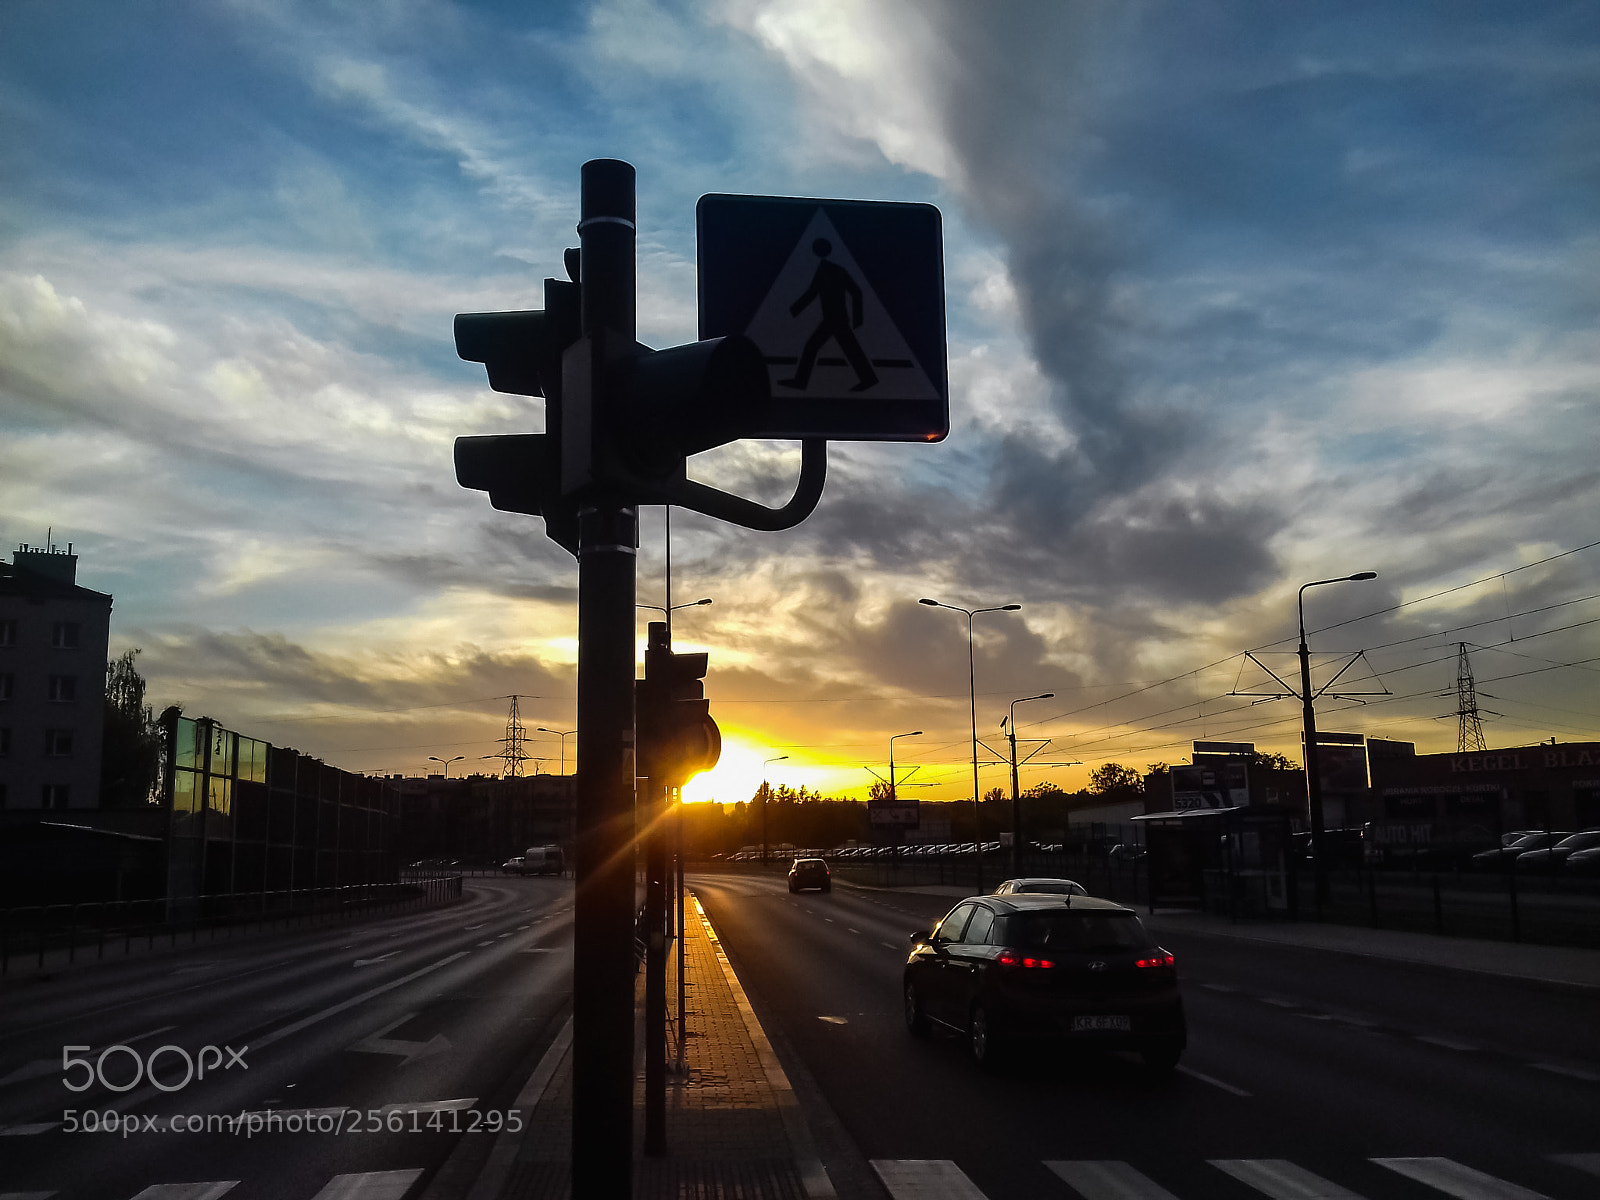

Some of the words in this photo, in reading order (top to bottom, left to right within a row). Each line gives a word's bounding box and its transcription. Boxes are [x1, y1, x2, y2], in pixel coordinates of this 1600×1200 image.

[1450, 755, 1528, 772] KEGEL
[1175, 797, 1201, 809] 5320
[1076, 1017, 1092, 1029] KR
